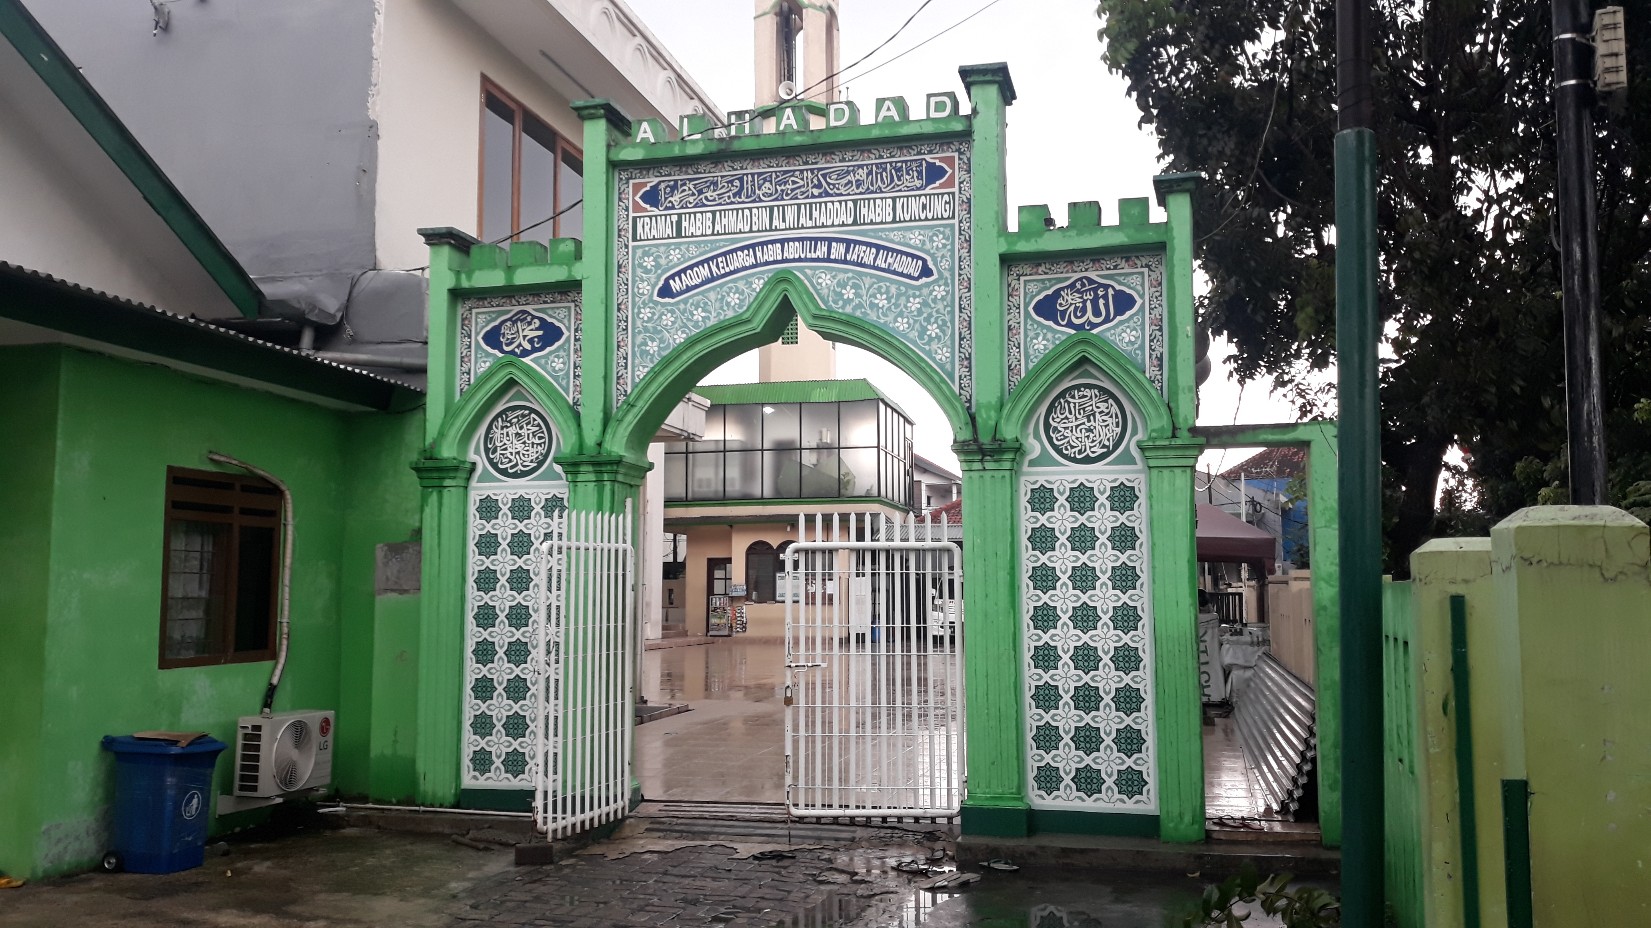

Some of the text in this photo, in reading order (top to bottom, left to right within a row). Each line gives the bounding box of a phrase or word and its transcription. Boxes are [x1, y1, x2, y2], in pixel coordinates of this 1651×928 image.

[637, 193, 953, 240] KRAMAT HABIB AHMAD BIN ALWI ALHADDAD (HABIB KUNCUNG)
[669, 241, 923, 294] MAQOM KELUARGA HABIB ABDULLAH BIN JA'FAR ALHADDAD
[319, 740, 328, 751] LG
